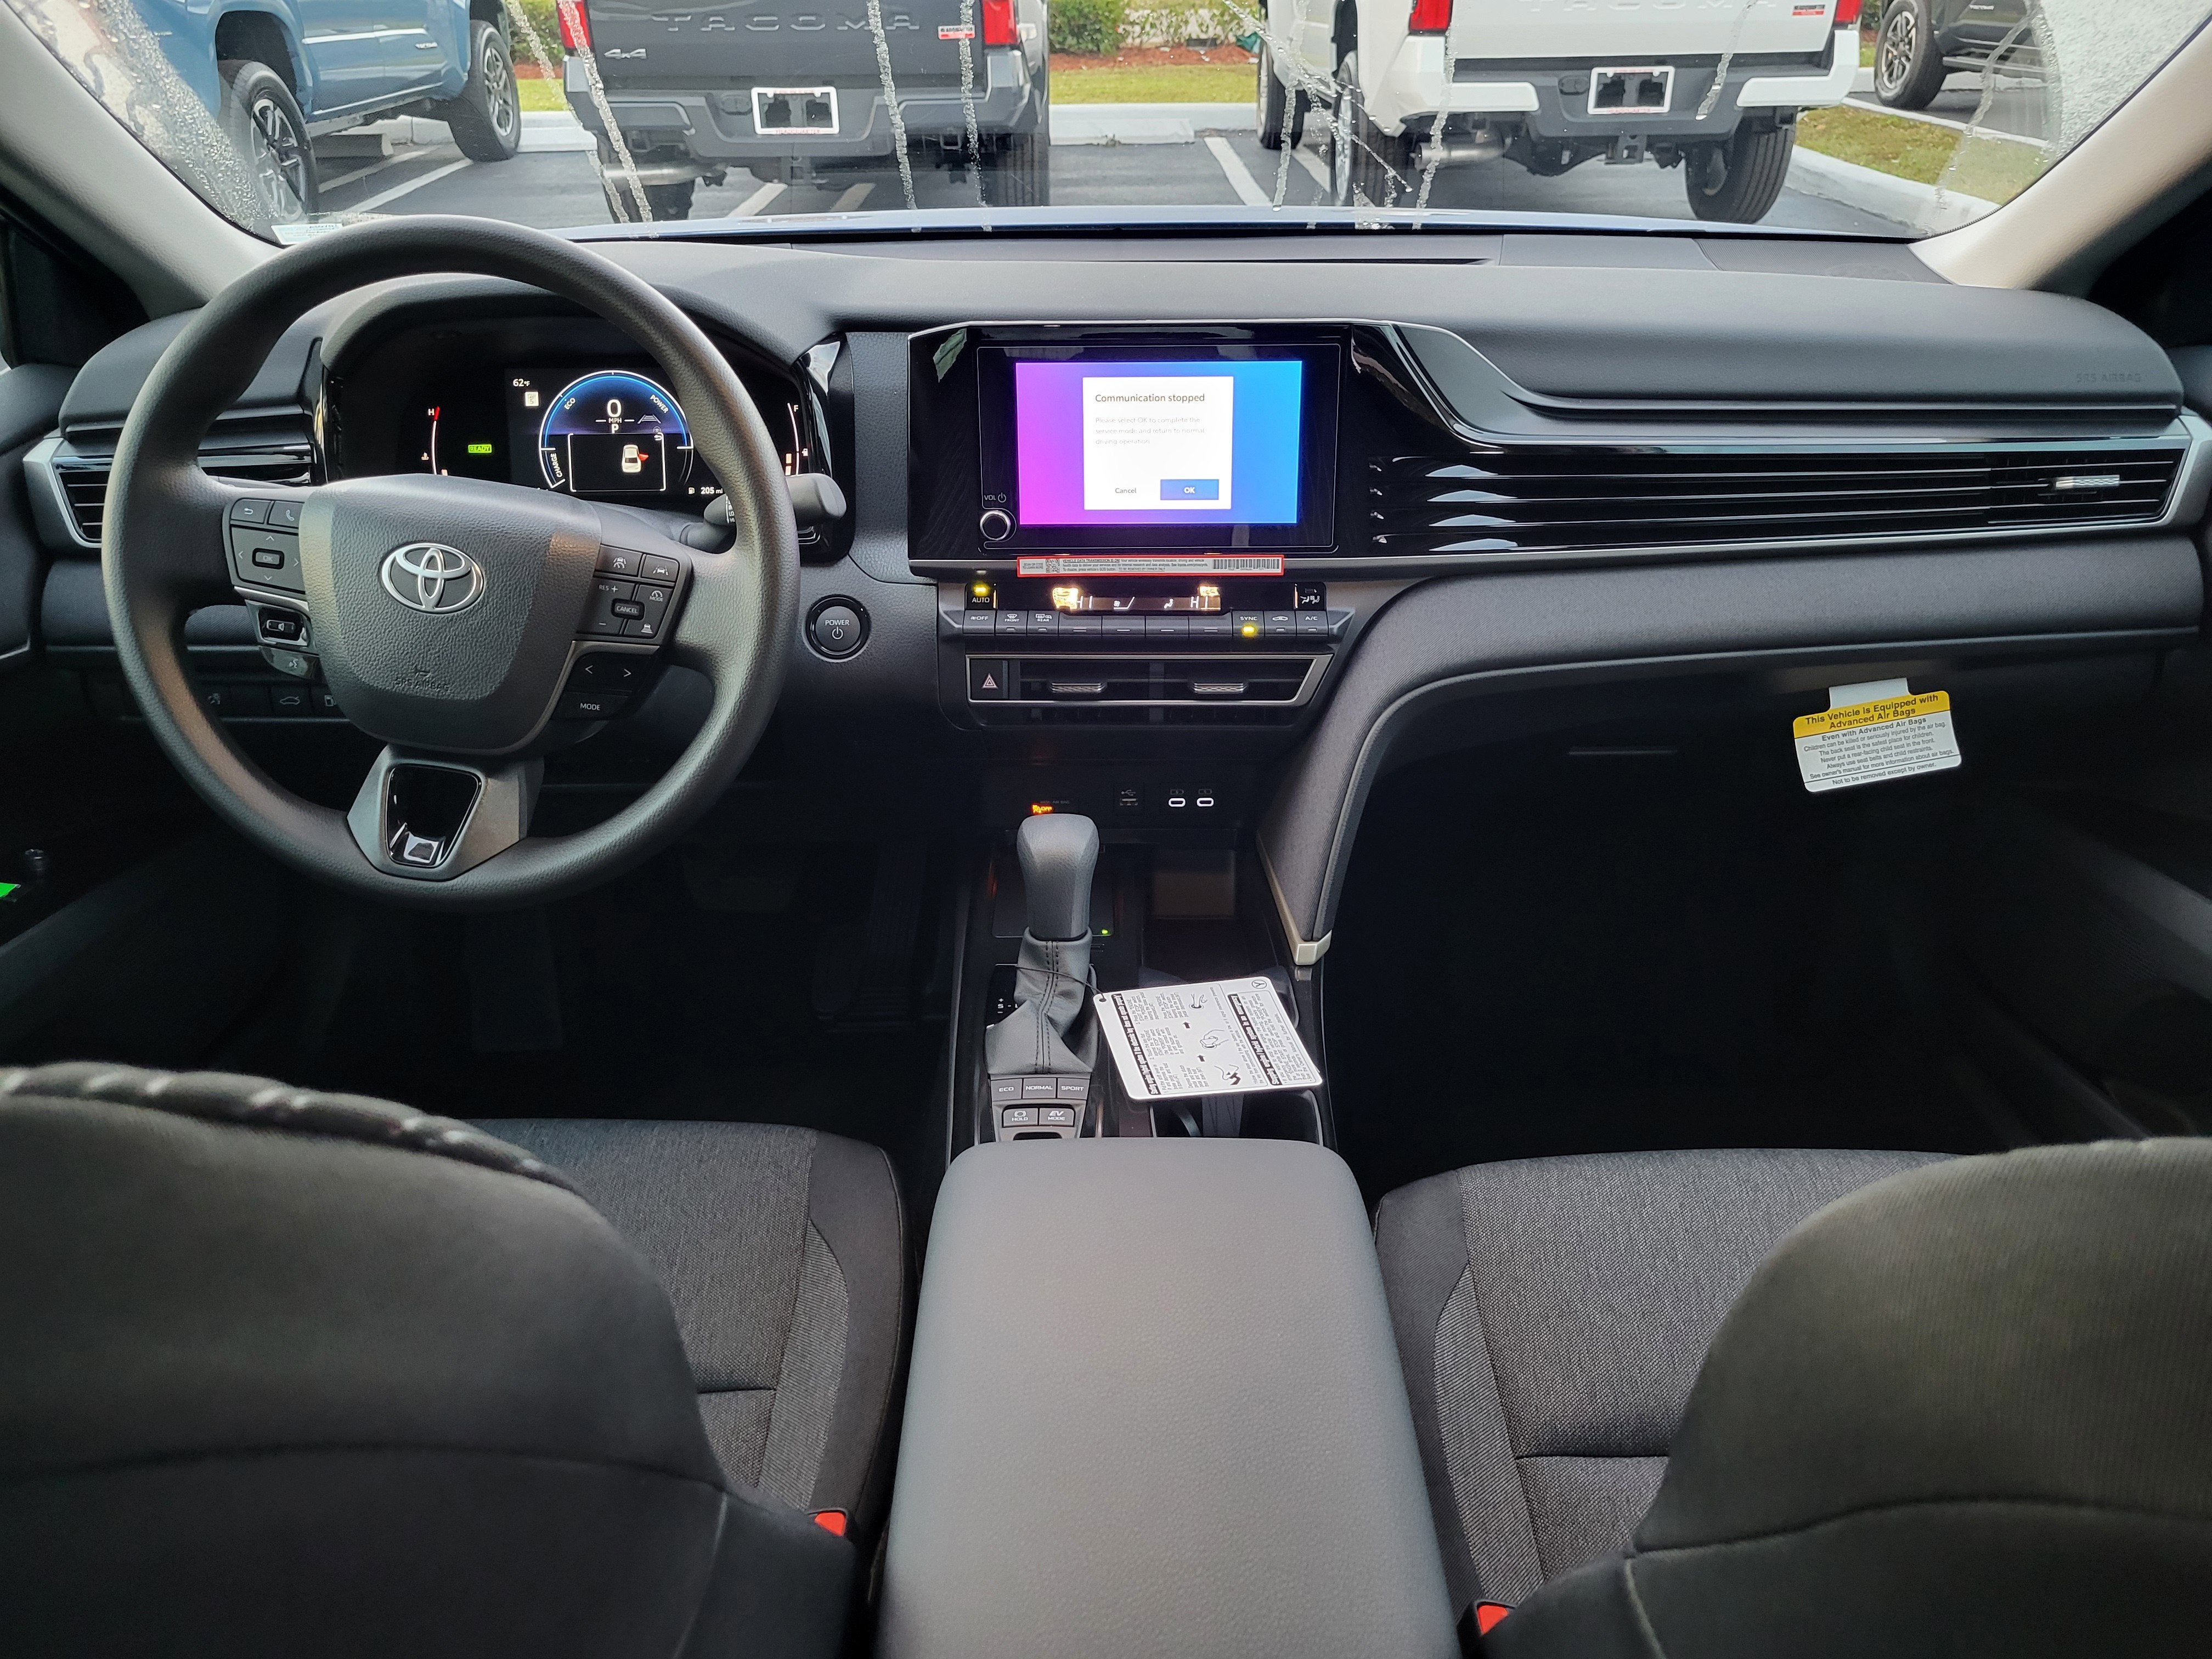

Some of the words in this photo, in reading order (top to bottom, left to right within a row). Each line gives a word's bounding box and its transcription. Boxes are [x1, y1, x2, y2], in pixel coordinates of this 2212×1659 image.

[651, 14, 920, 31] TACOMA
[564, 398, 576, 410] ECO
[650, 394, 668, 414] POWER
[1095, 393, 1165, 402] Communication
[1168, 393, 1205, 404] stopped
[607, 399, 622, 417] 0
[611, 424, 619, 433] P
[550, 453, 563, 478] CHARGE
[617, 606, 637, 614] CANCEL
[580, 703, 601, 711] MODE
[1805, 714, 1825, 724] This
[1827, 708, 1860, 720] Vehicle
[1872, 697, 1917, 713] Equipped
[1918, 693, 1938, 703] with
[1828, 714, 1875, 729] Advanced
[1876, 711, 1890, 720] Air
[1892, 706, 1916, 719] Bags
[1821, 732, 1839, 741] Even
[1858, 723, 1894, 734] Advanced
[1908, 716, 1927, 726] Bags
[1911, 730, 1933, 739] children.
[1803, 742, 1826, 752] Children
[1866, 731, 1890, 741] seriously
[1851, 747, 1880, 758] rear-facing
[1826, 761, 1845, 770] Always
[1885, 755, 1914, 765] information
[1860, 770, 1886, 780] removed
[1887, 767, 1907, 776] except
